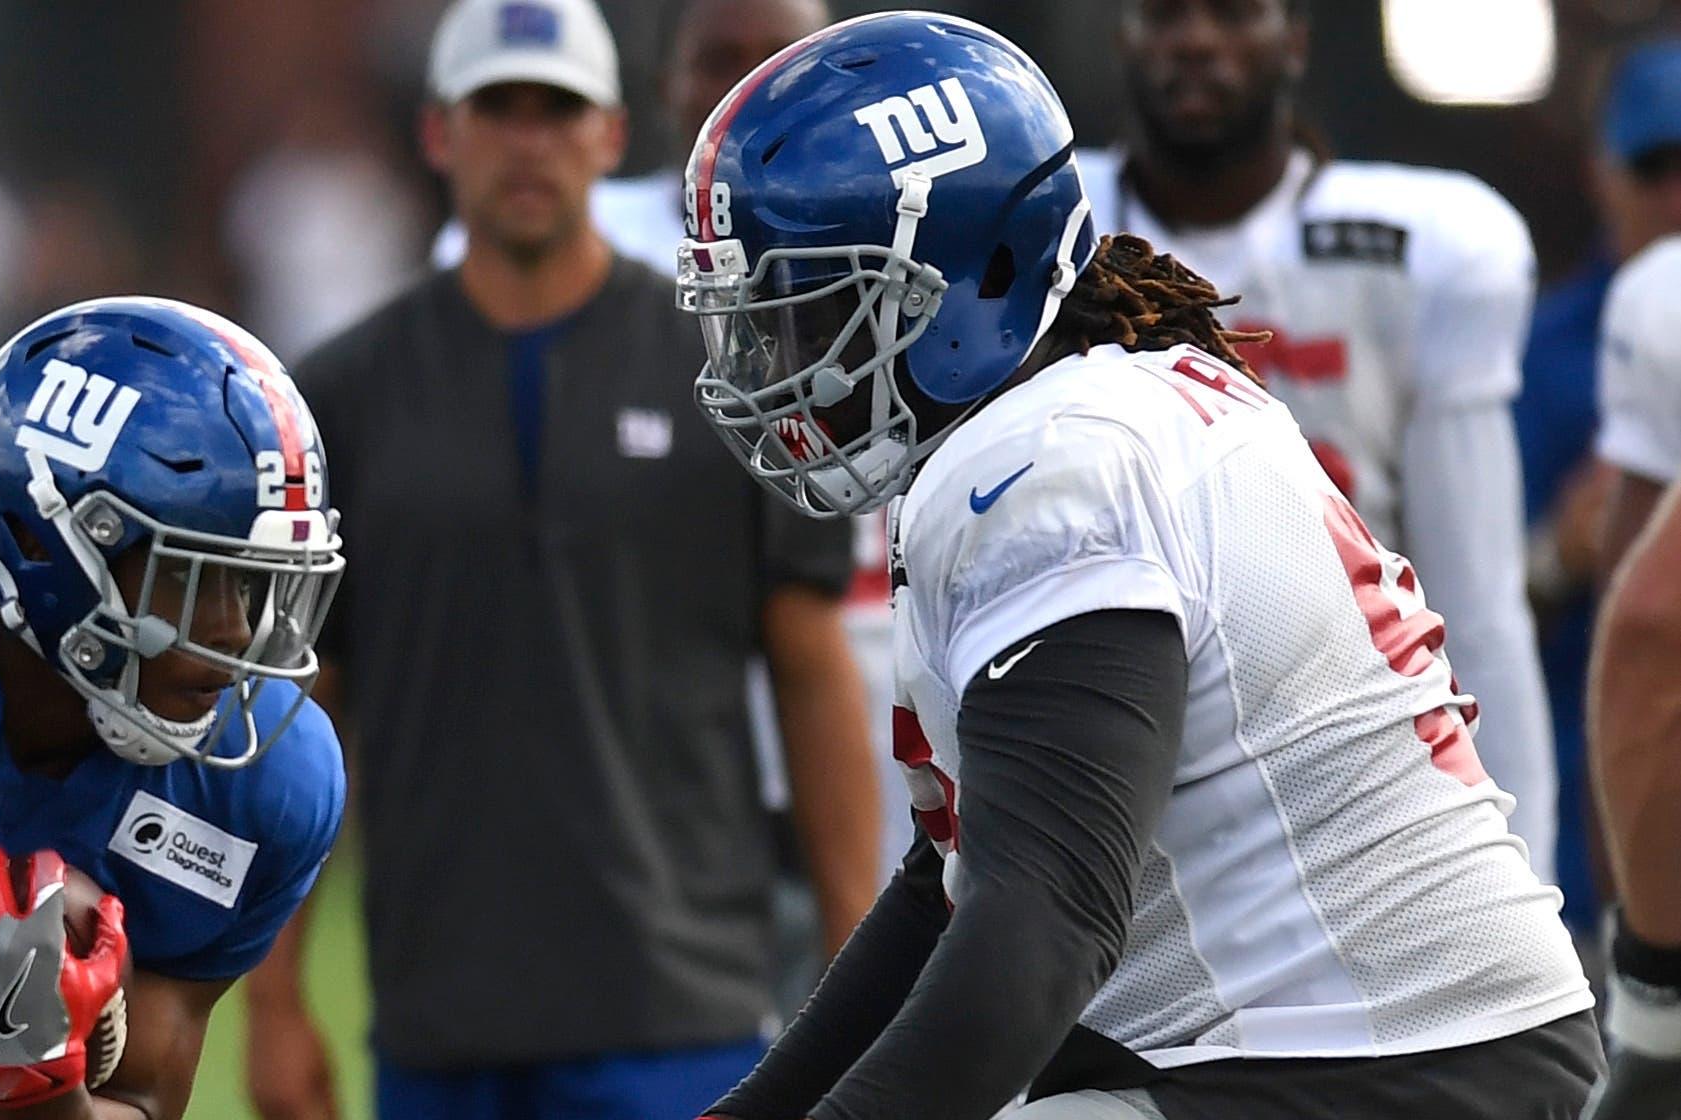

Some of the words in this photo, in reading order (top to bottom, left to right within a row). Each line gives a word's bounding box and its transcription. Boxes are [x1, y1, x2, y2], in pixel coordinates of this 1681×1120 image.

[685, 182, 733, 236] 98
[256, 450, 323, 509] 26
[166, 848, 233, 888] Diagnostics
[172, 831, 226, 870] Quest
